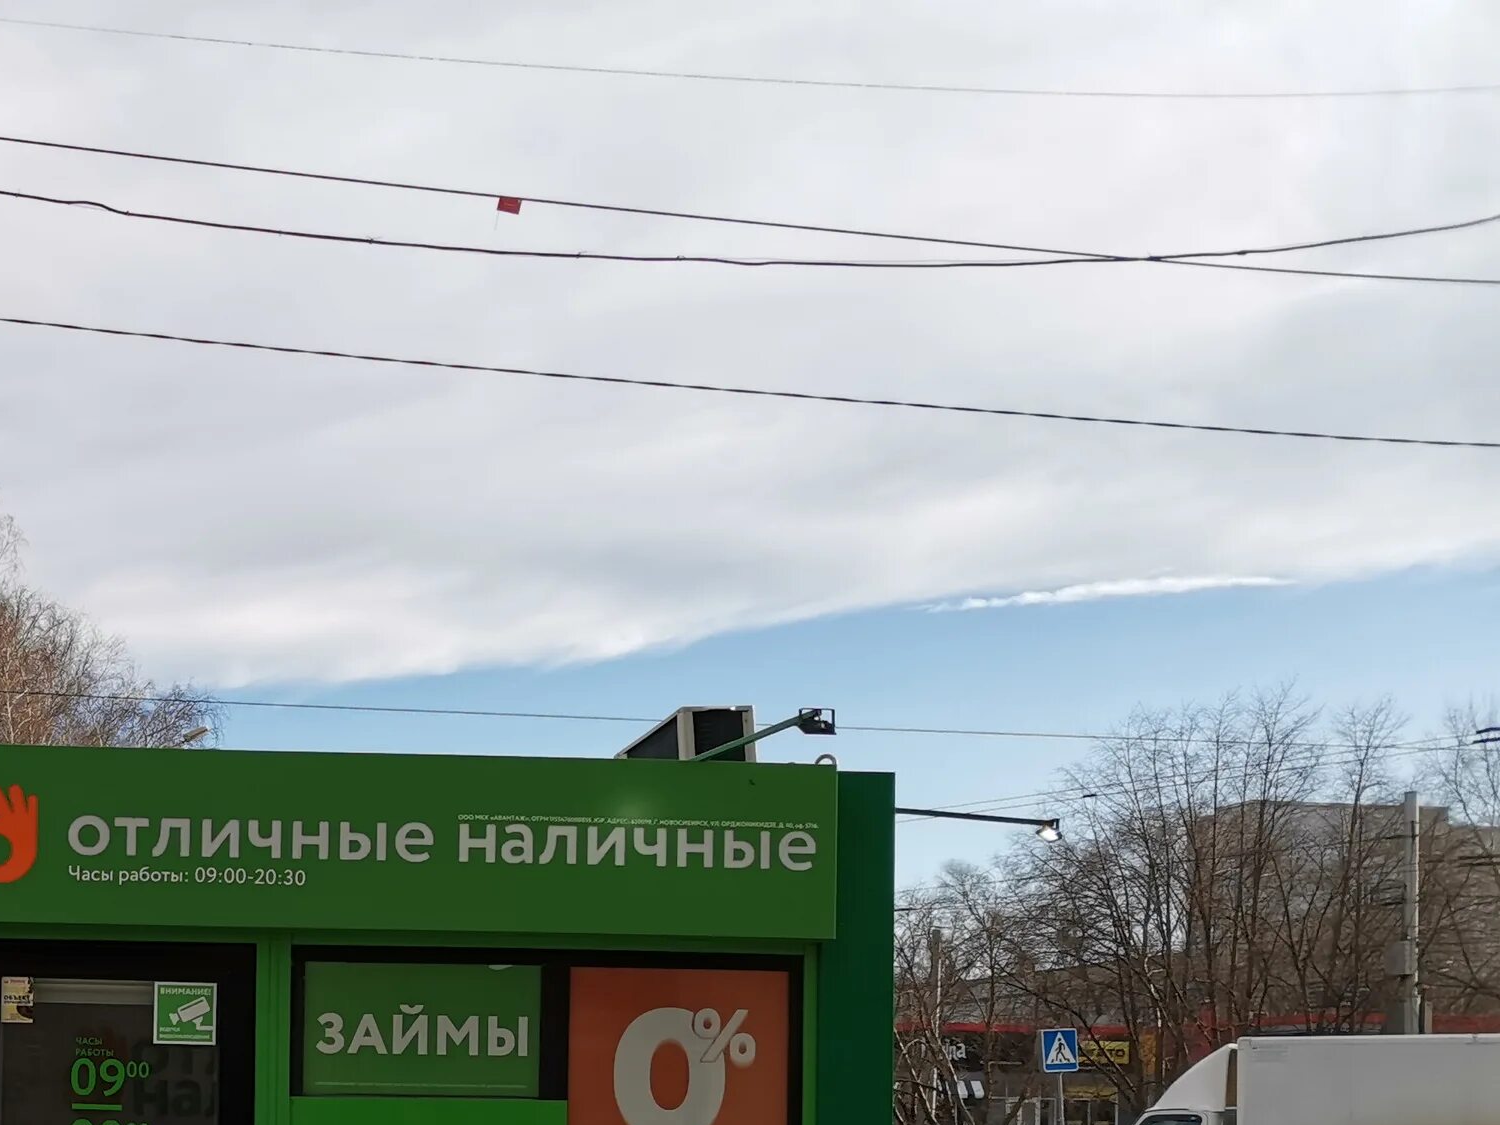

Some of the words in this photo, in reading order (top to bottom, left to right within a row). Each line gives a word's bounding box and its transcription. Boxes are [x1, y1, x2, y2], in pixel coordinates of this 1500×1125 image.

[68, 814, 434, 864] отличные
[458, 820, 817, 872] наличные
[68, 865, 114, 882] Часы
[118, 866, 189, 886] работы:
[194, 866, 306, 886] 09:00-20:30
[315, 1004, 529, 1057] ЗАЙМЫ
[75, 1037, 103, 1046] ЧАСЫ
[75, 1048, 114, 1057] РАБОТЫ
